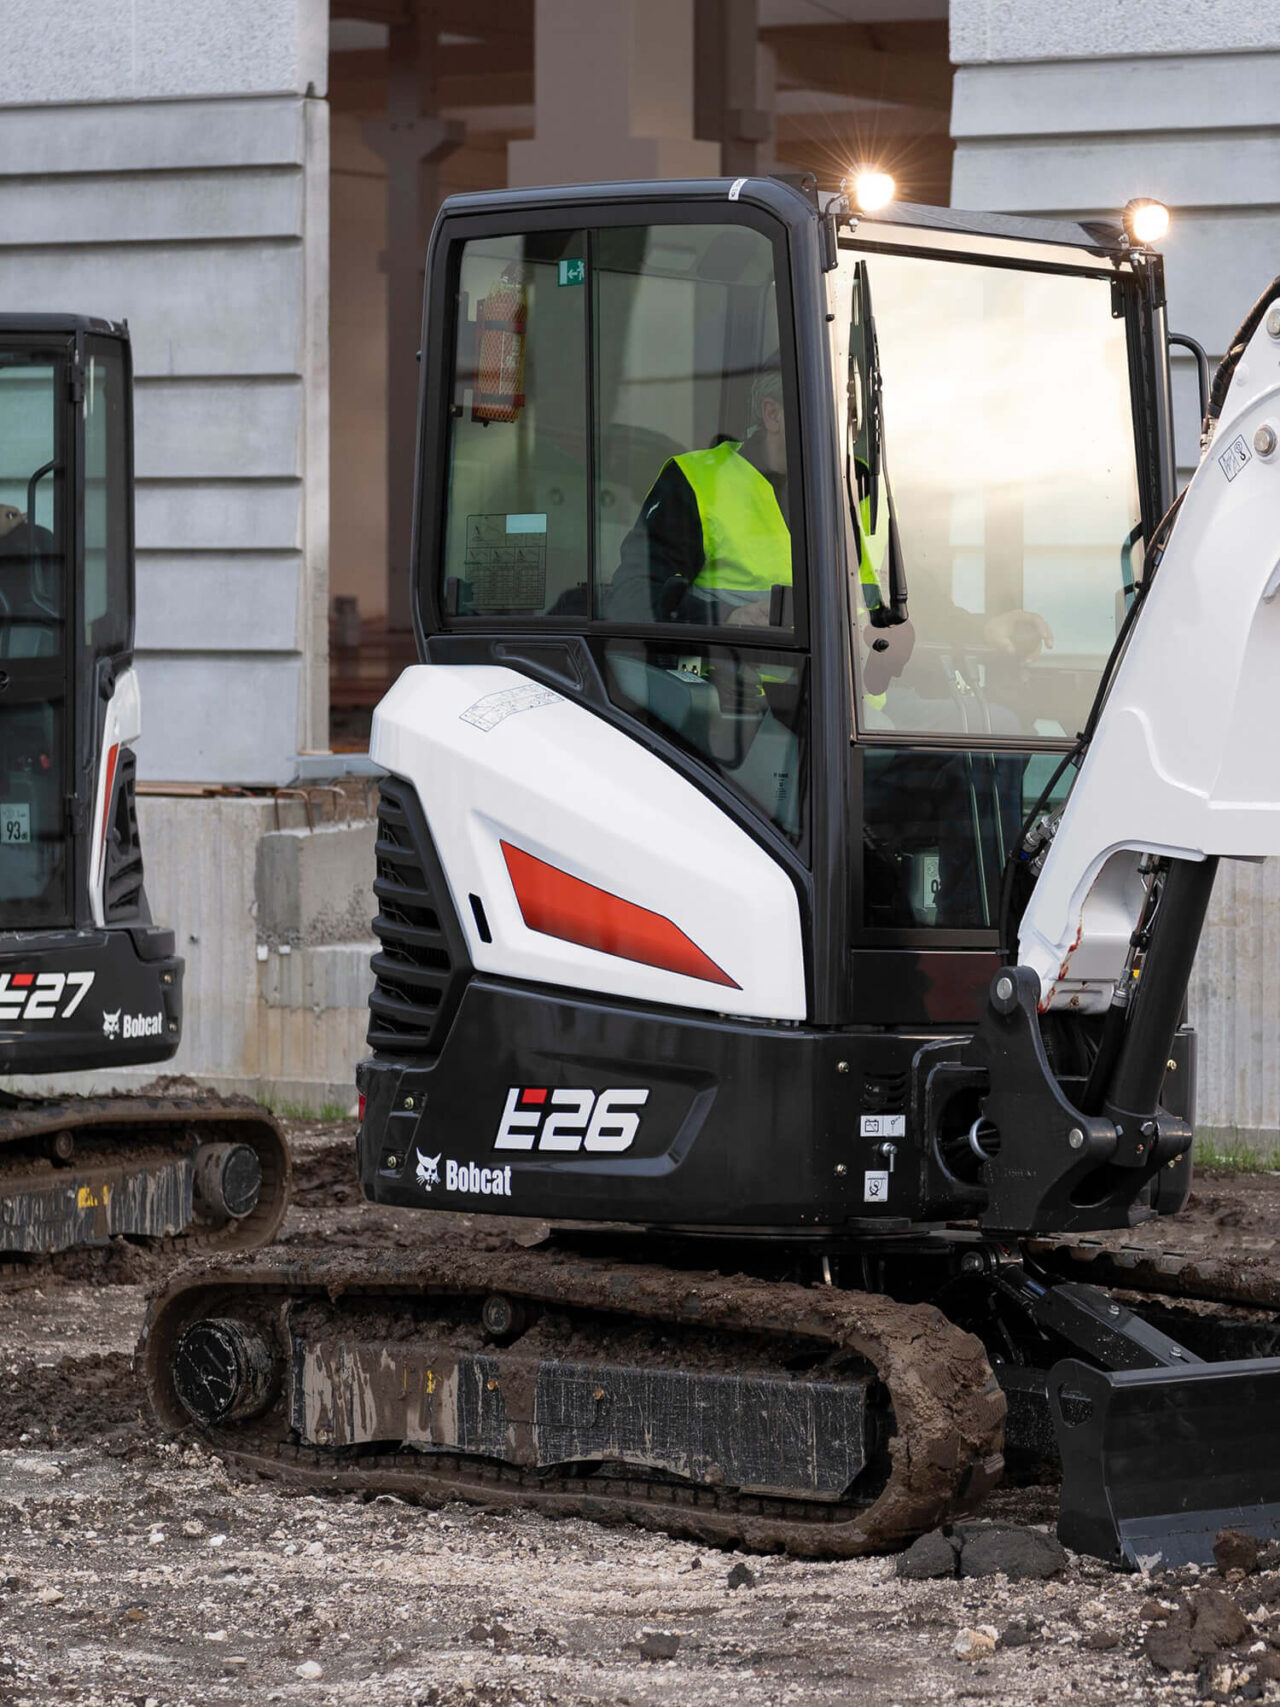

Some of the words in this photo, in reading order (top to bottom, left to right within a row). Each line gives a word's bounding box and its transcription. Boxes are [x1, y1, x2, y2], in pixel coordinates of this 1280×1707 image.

[6, 820, 21, 840] 93
[0, 971, 95, 1020] E27
[123, 1011, 163, 1039] Bobcat
[494, 1088, 650, 1152] E26
[446, 1159, 512, 1196] Bobcat
